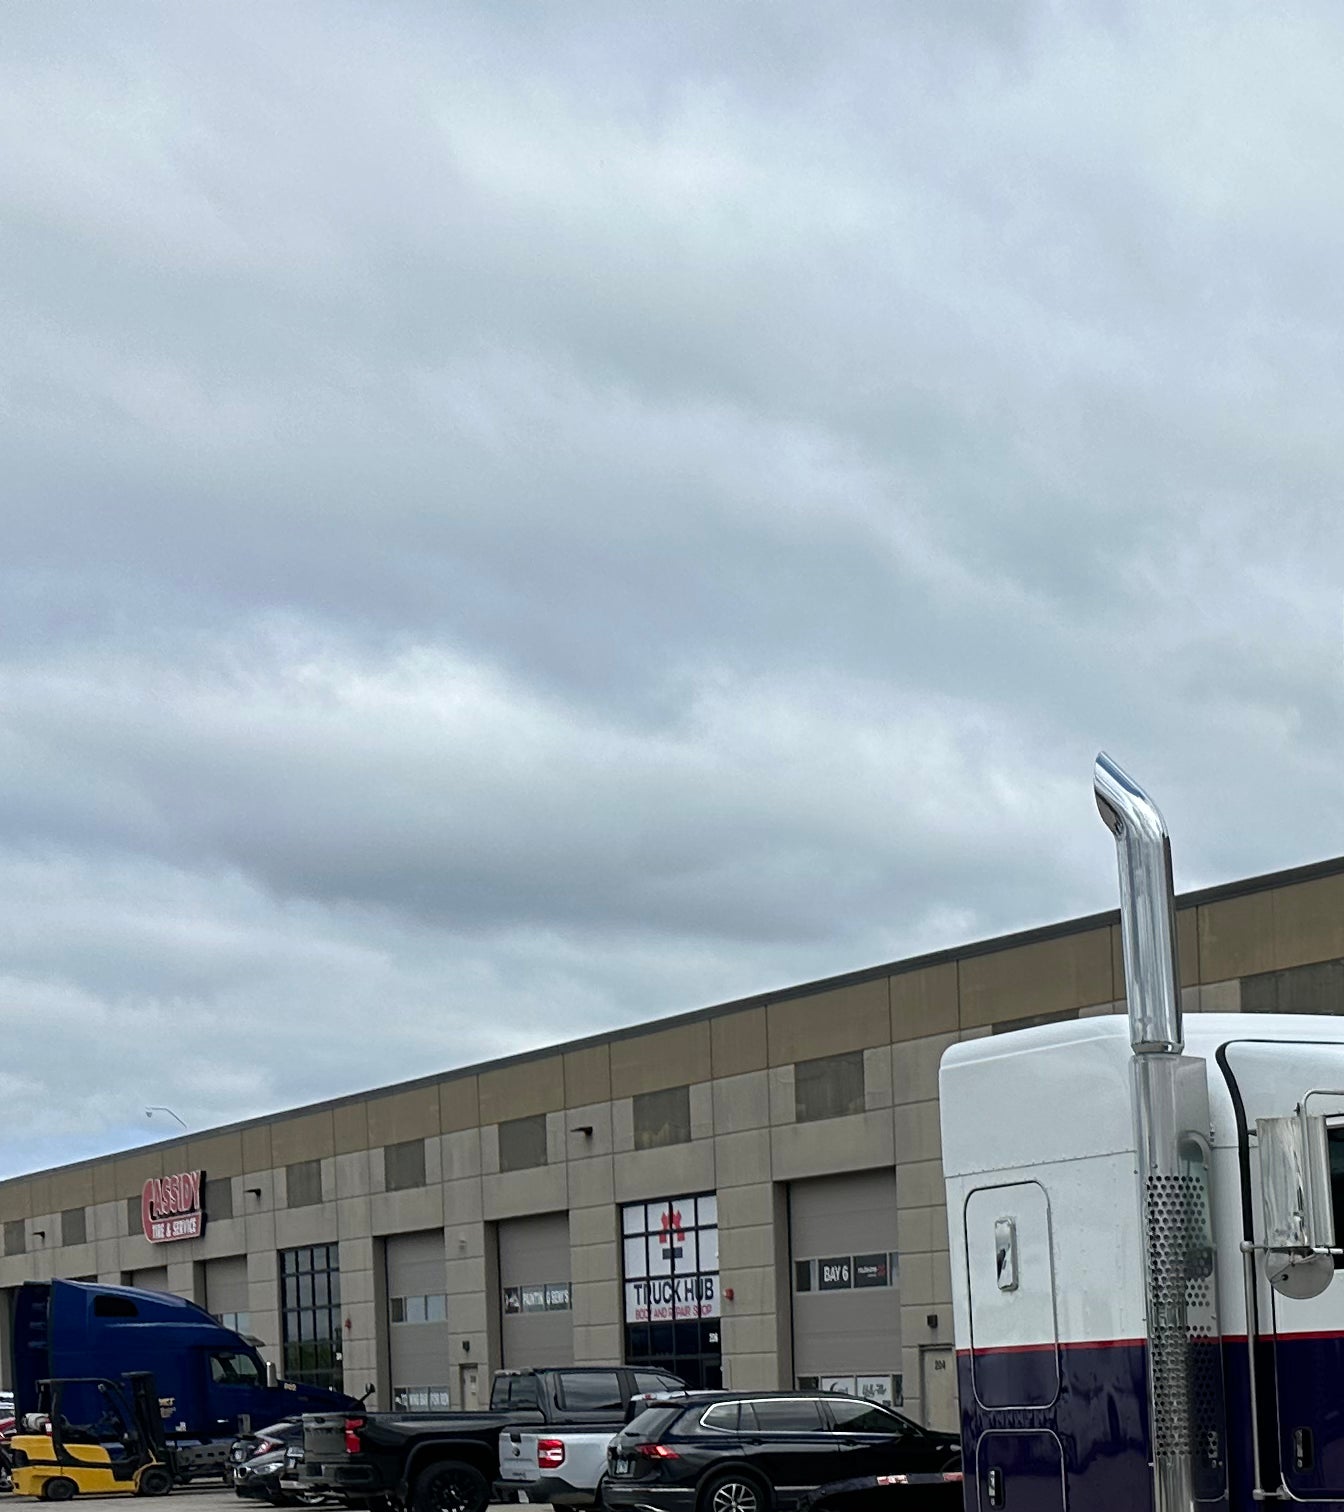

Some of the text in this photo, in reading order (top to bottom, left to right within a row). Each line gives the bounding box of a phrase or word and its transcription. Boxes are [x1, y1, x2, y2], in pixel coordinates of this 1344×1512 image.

[141, 1169, 201, 1217] CASSIDY
[823, 1265, 841, 1282] BAY
[841, 1265, 849, 1281] 6
[634, 1278, 714, 1305] TRUCK HUB
[668, 1306, 691, 1318] RPAIR
